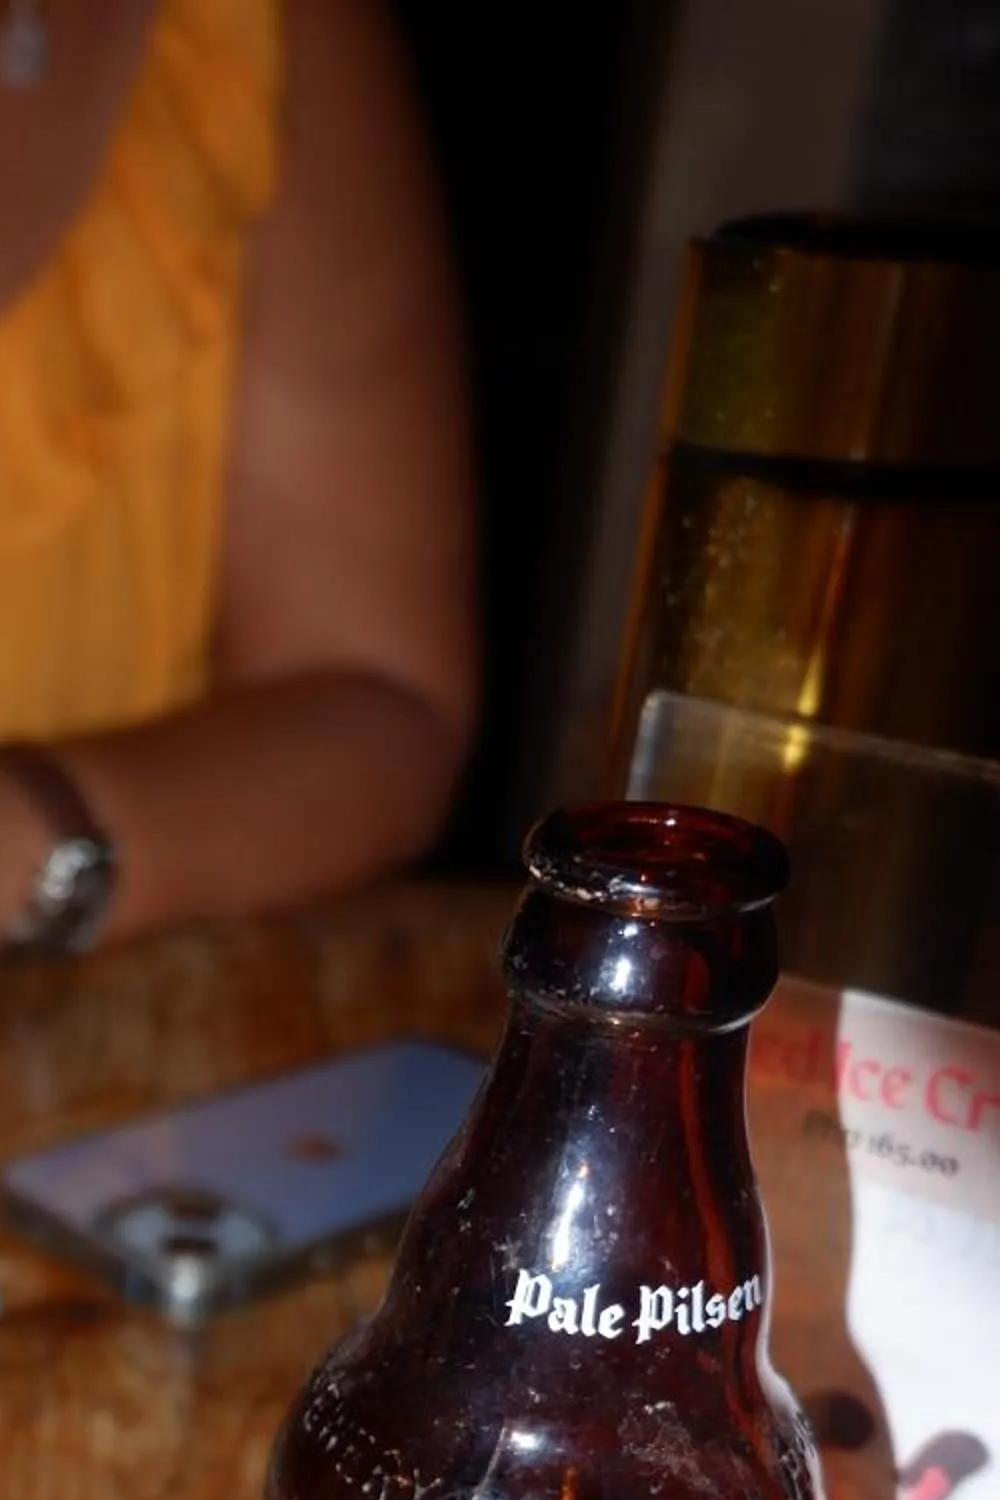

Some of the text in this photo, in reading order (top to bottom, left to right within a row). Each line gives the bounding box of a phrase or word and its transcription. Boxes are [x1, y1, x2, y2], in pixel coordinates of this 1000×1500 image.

[924, 1064, 1000, 1132] Cr
[504, 1267, 762, 1345] Pale Pilsen
